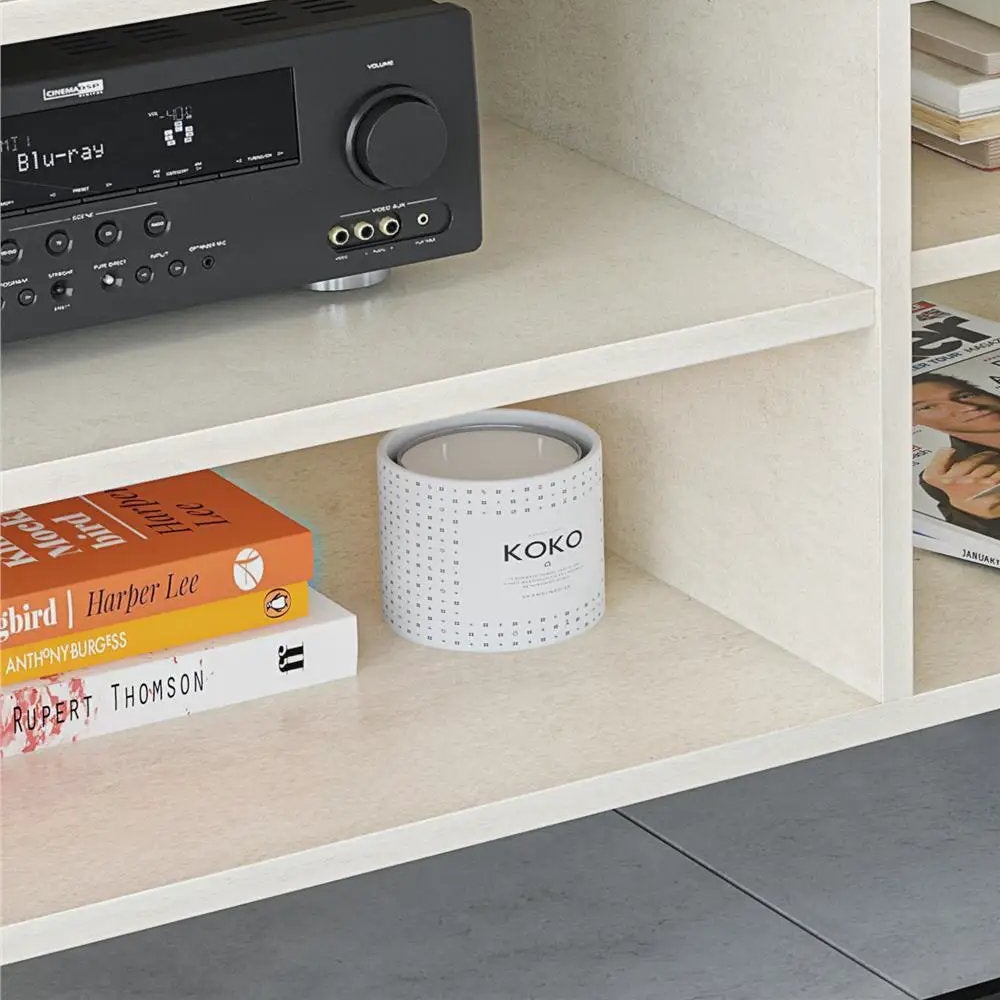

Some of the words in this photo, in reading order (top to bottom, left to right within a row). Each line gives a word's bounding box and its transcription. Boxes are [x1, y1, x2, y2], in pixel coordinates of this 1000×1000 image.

[18, 144, 104, 172] Blu-ray
[0, 511, 84, 559] Mock
[50, 511, 127, 550] bird
[176, 502, 232, 527] Lee
[504, 529, 582, 562] KOKO
[86, 583, 160, 617] Harper
[165, 573, 199, 600] Lee
[5, 645, 70, 674] ANTHONY
[69, 631, 127, 660] BURGESS
[13, 695, 93, 733] RUPERT
[111, 670, 204, 711] THOMSON
